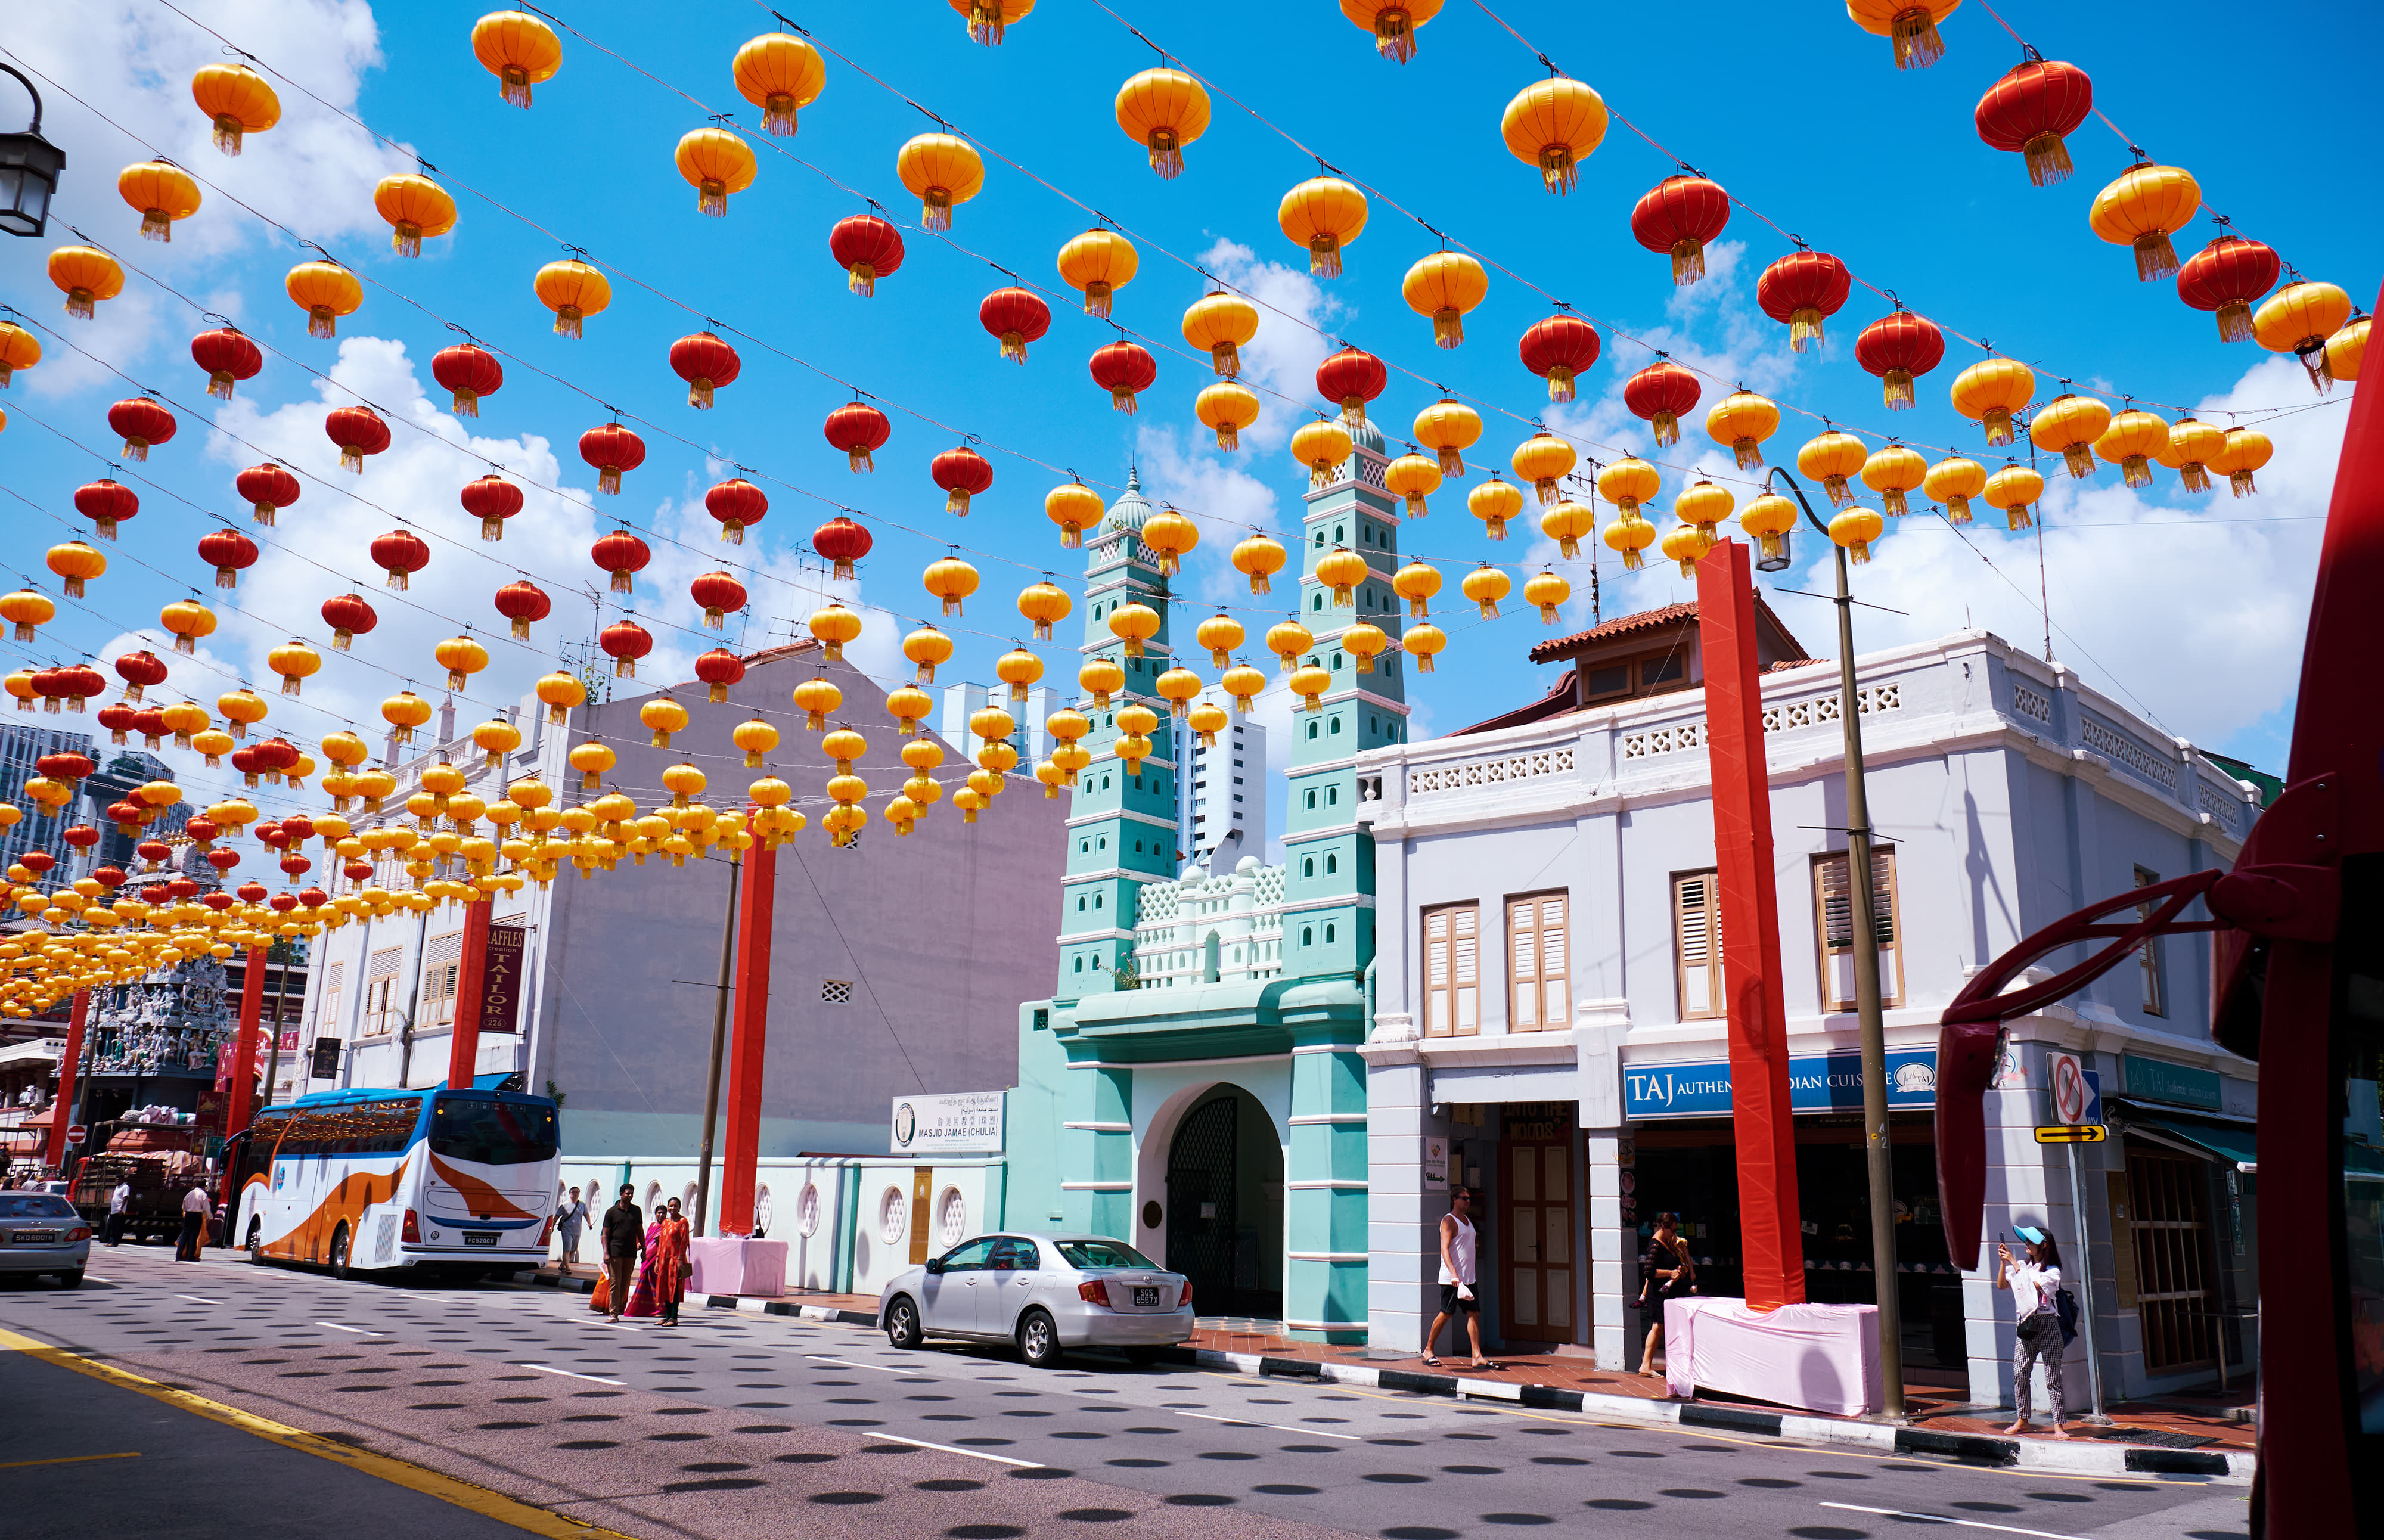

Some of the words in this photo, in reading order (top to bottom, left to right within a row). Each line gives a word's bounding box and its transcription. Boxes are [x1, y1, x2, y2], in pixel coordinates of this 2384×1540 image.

[486, 954, 510, 1015] TAILOR
[1627, 1074, 1674, 1107] TAJ
[1677, 1081, 1732, 1095] AUTHEN
[1789, 1075, 1821, 1089] DIAN
[1827, 1072, 1892, 1088] CUISE
[2150, 1069, 2164, 1097] TAJ
[918, 1128, 942, 1138] MASJID
[944, 1128, 967, 1137] JAMAE
[968, 1126, 998, 1137] (CHULIA)
[1510, 1122, 1554, 1140] WOODS
